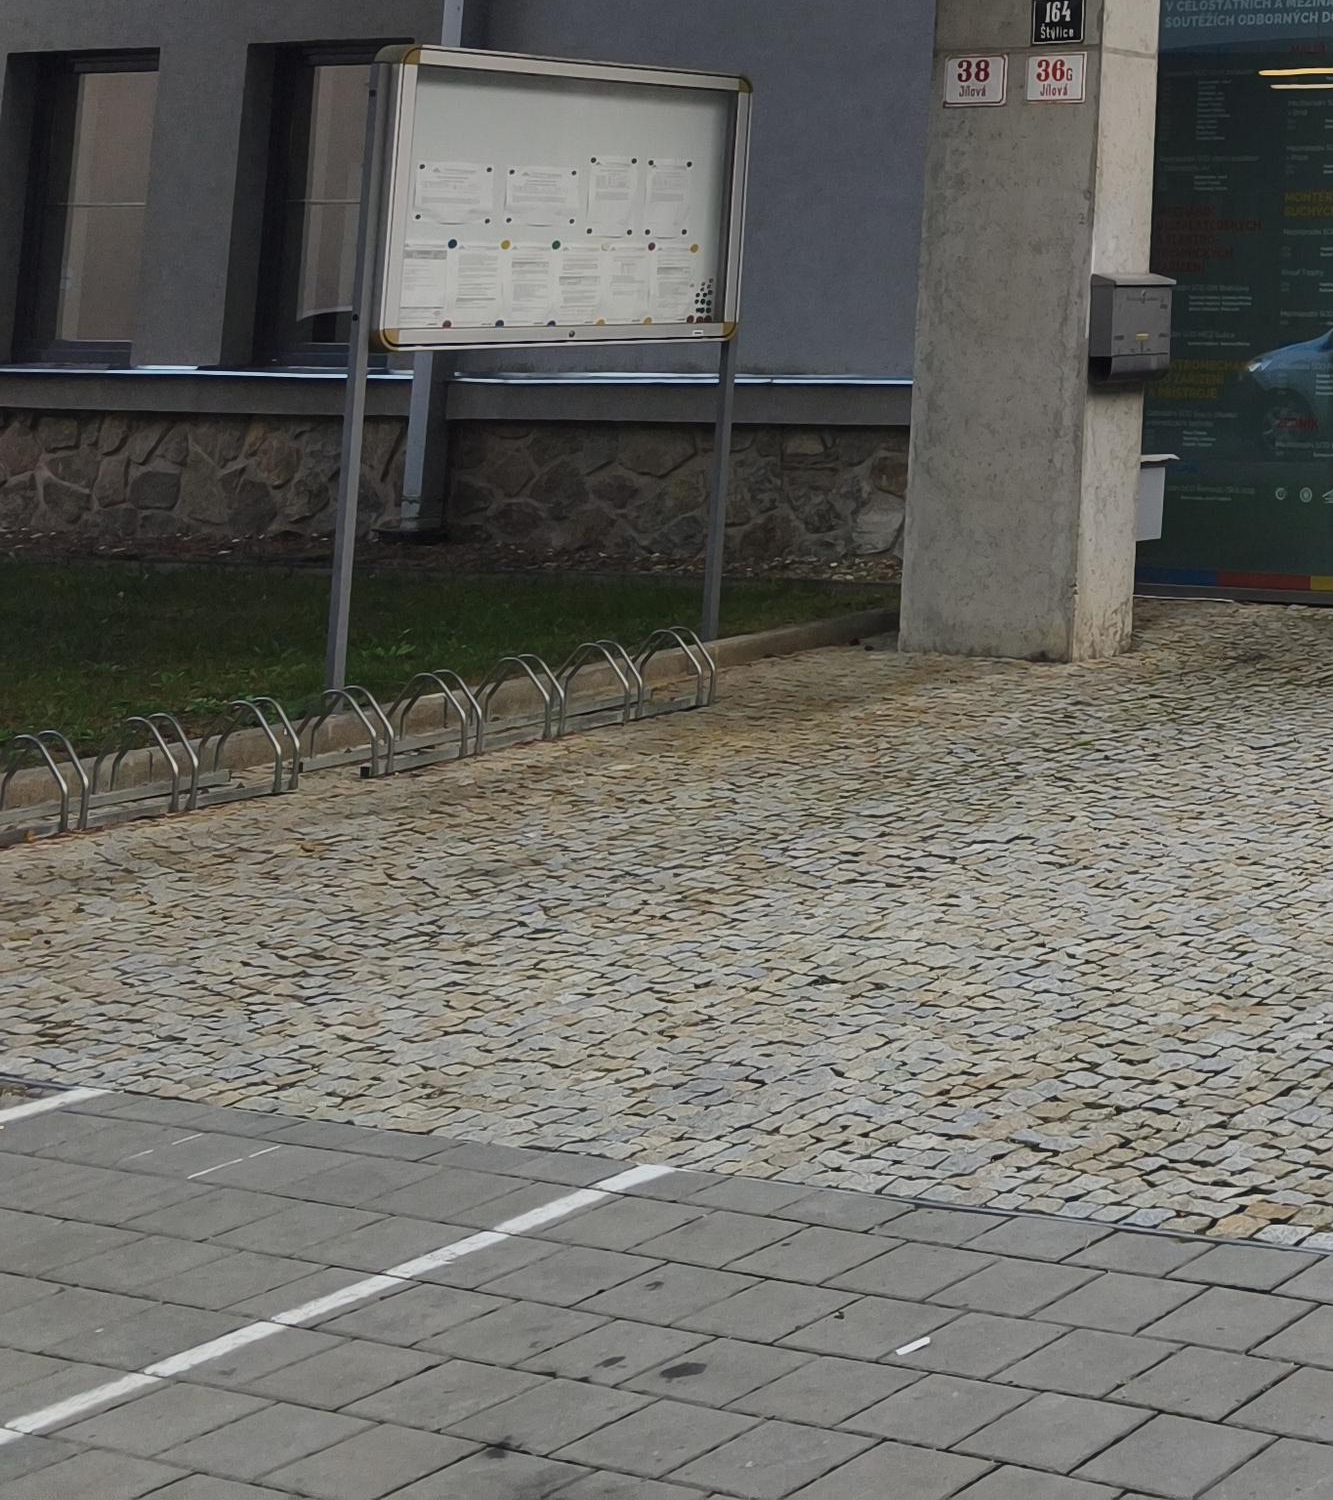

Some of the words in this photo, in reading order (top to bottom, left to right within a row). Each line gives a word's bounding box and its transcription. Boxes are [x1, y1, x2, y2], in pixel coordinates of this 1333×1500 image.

[1045, 1, 1071, 23] 164
[1165, 1, 1173, 12] V
[1164, 13, 1235, 29] SOUTĚŽÍCH
[1238, 10, 1319, 26] ODBORNÝCH
[957, 59, 990, 82] 38
[1036, 58, 1073, 82] 36G
[958, 84, 987, 97] Jílová
[1039, 83, 1068, 97] Jílová
